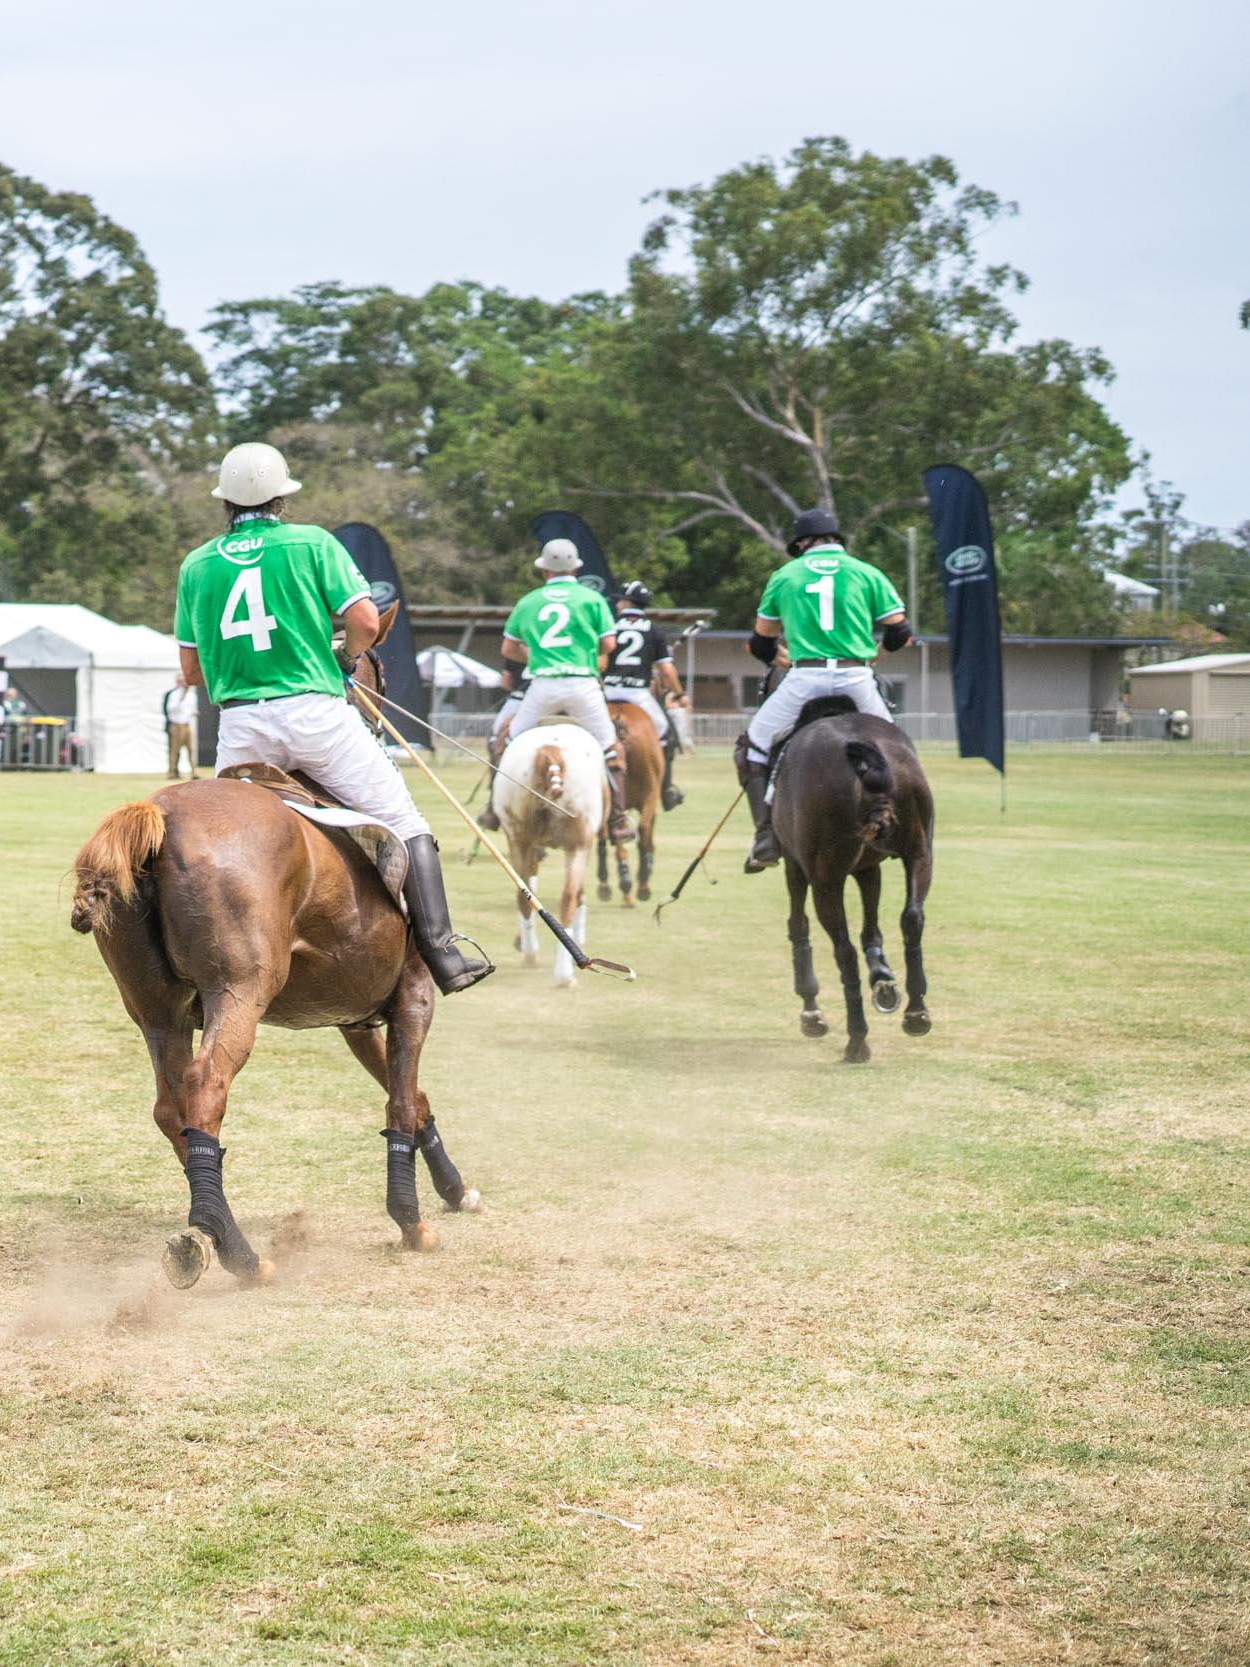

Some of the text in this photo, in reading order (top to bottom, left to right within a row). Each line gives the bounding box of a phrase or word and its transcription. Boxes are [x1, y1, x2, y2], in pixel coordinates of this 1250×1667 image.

[226, 536, 263, 553] CGU
[219, 566, 278, 652] 4
[538, 603, 573, 648] 2
[805, 575, 834, 631] 1
[615, 630, 644, 665] 2
